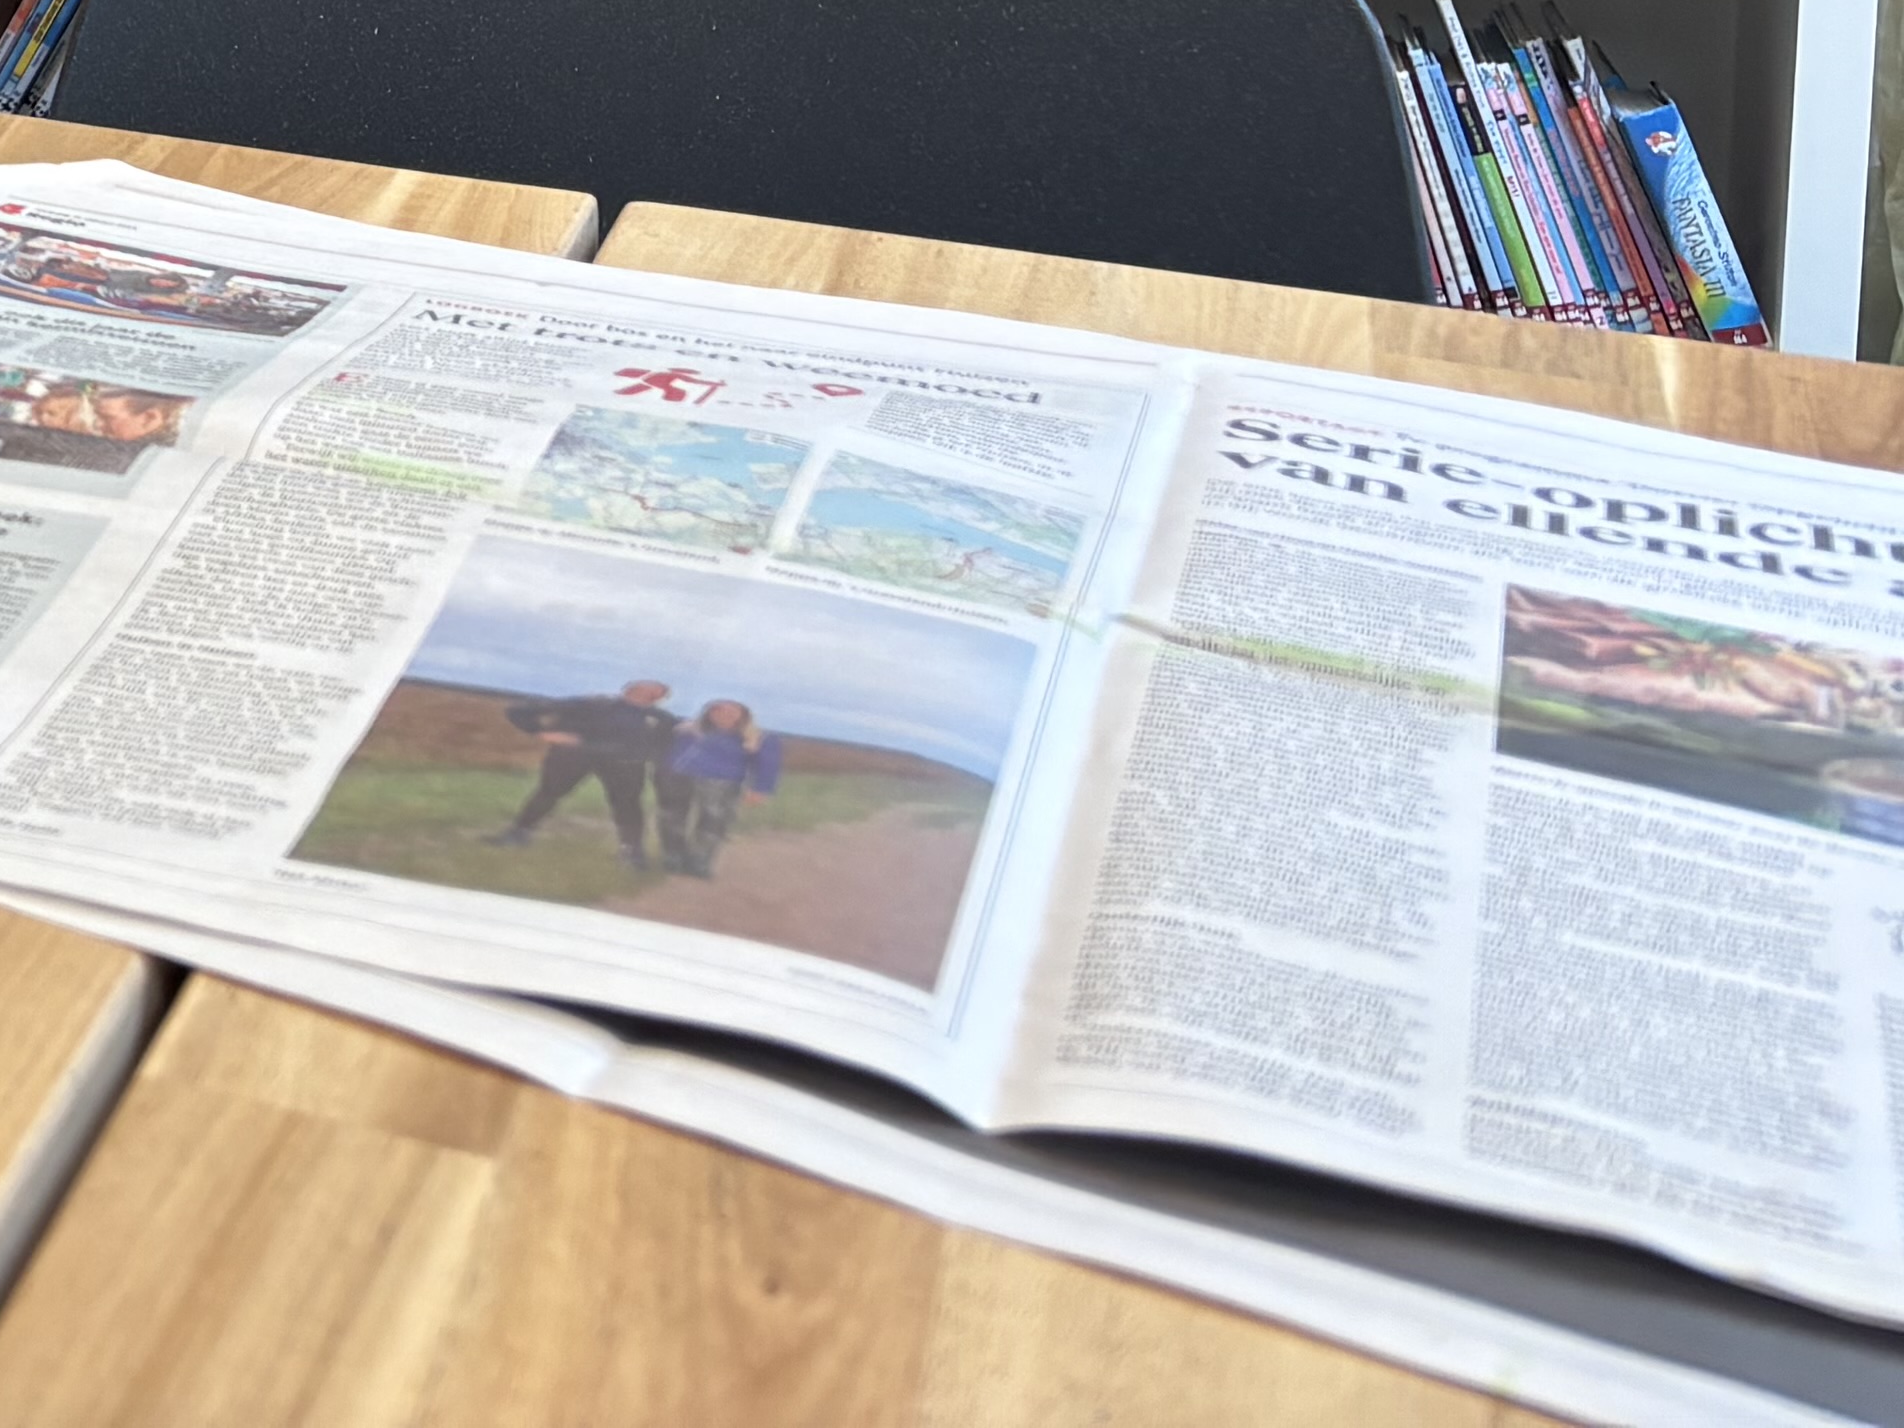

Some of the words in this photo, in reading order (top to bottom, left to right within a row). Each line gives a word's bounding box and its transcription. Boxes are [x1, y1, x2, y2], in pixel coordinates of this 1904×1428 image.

[413, 308, 510, 331] Met
[674, 345, 740, 364] en
[1216, 450, 1409, 504] van
[1444, 496, 1855, 586] ellende
